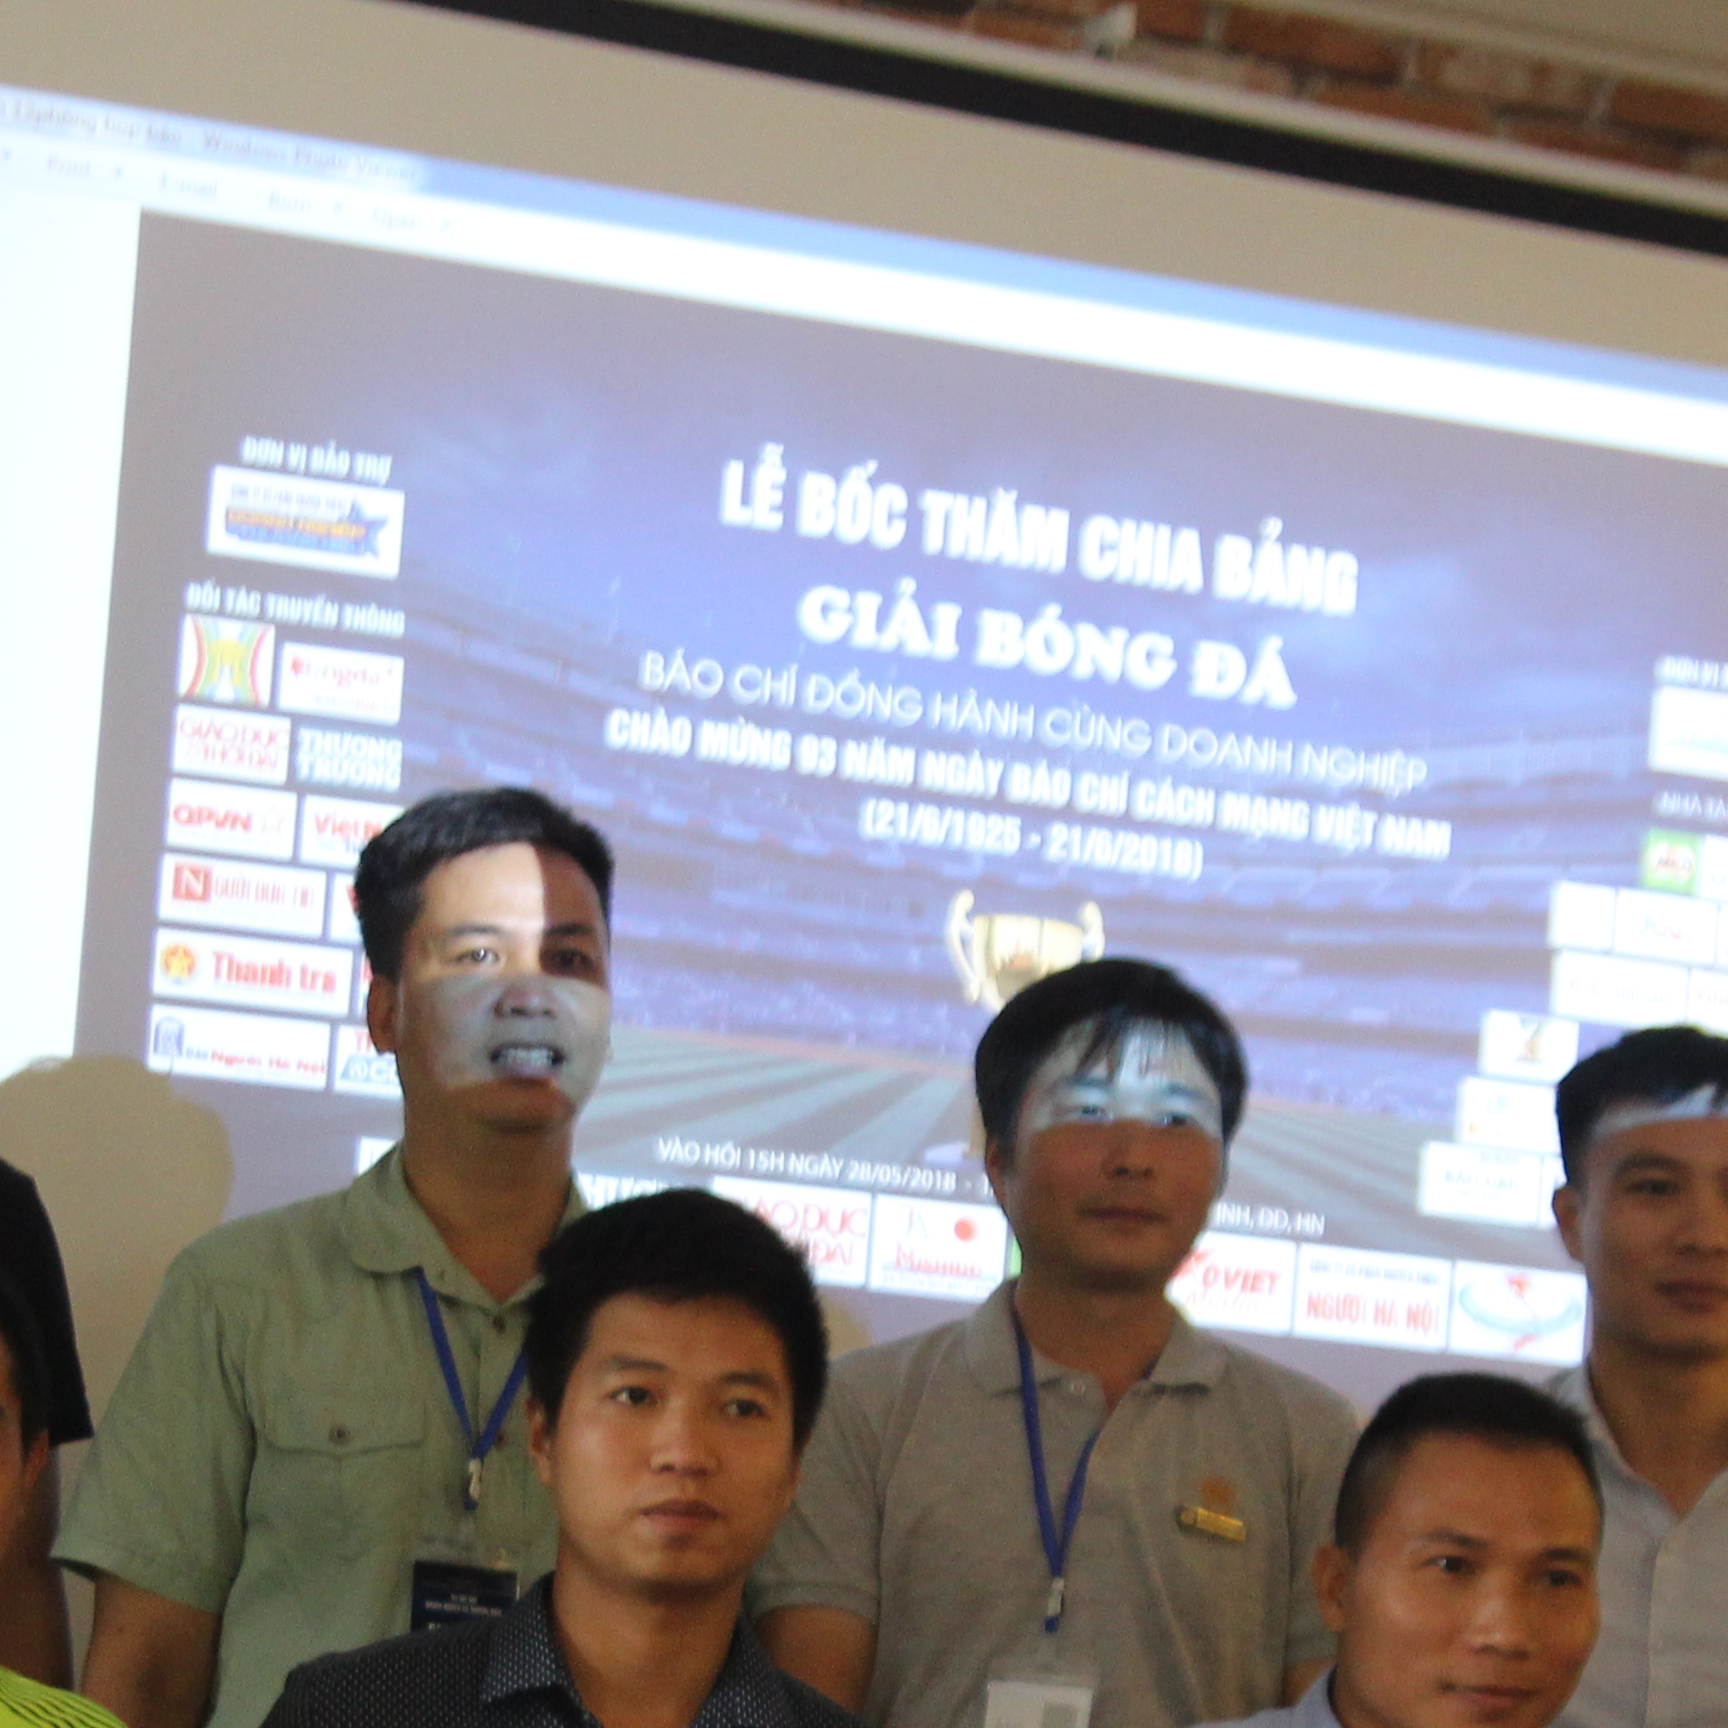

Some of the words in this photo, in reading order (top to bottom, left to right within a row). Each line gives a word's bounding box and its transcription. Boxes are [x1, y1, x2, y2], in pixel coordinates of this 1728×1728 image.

[720, 441, 787, 532] LỄ
[796, 459, 909, 550] BỐC
[918, 487, 1070, 574] THĂM
[1080, 514, 1203, 595] CHIA
[1213, 517, 1358, 616] BẢNG
[798, 577, 962, 661] GIẢI
[976, 602, 1177, 691] BÓNG
[1189, 634, 1297, 711] ĐÁ
[605, 707, 692, 757] CHÀO
[695, 717, 792, 771] MỪNG
[795, 735, 837, 777] 93
[839, 737, 917, 787] NĂM
[917, 750, 1004, 799] NGÀY
[1005, 759, 1072, 809] BÁO
[1074, 770, 1129, 817] CHÍ
[1131, 777, 1216, 828] CÁCH
[1217, 790, 1311, 844] MẠNG
[1311, 802, 1377, 853] VIỆT
[1377, 814, 1452, 862] NAM
[639, 646, 723, 700] BÁO
[729, 664, 798, 708] CHÍ
[802, 668, 924, 726] ĐỒNG
[929, 689, 1034, 740] HÀNH
[1041, 704, 1152, 758] CÙNG
[1159, 722, 1293, 775] DOANH
[1299, 742, 1428, 799] NGHIỆP
[173, 803, 253, 832] QPVN
[213, 950, 292, 989] Thanh
[654, 1136, 701, 1166] VÀO
[749, 1148, 785, 1173] 15H
[789, 1151, 844, 1183] NGÀY
[846, 1159, 956, 1192] 28/05/2018
[1295, 1211, 1325, 1237] HN
